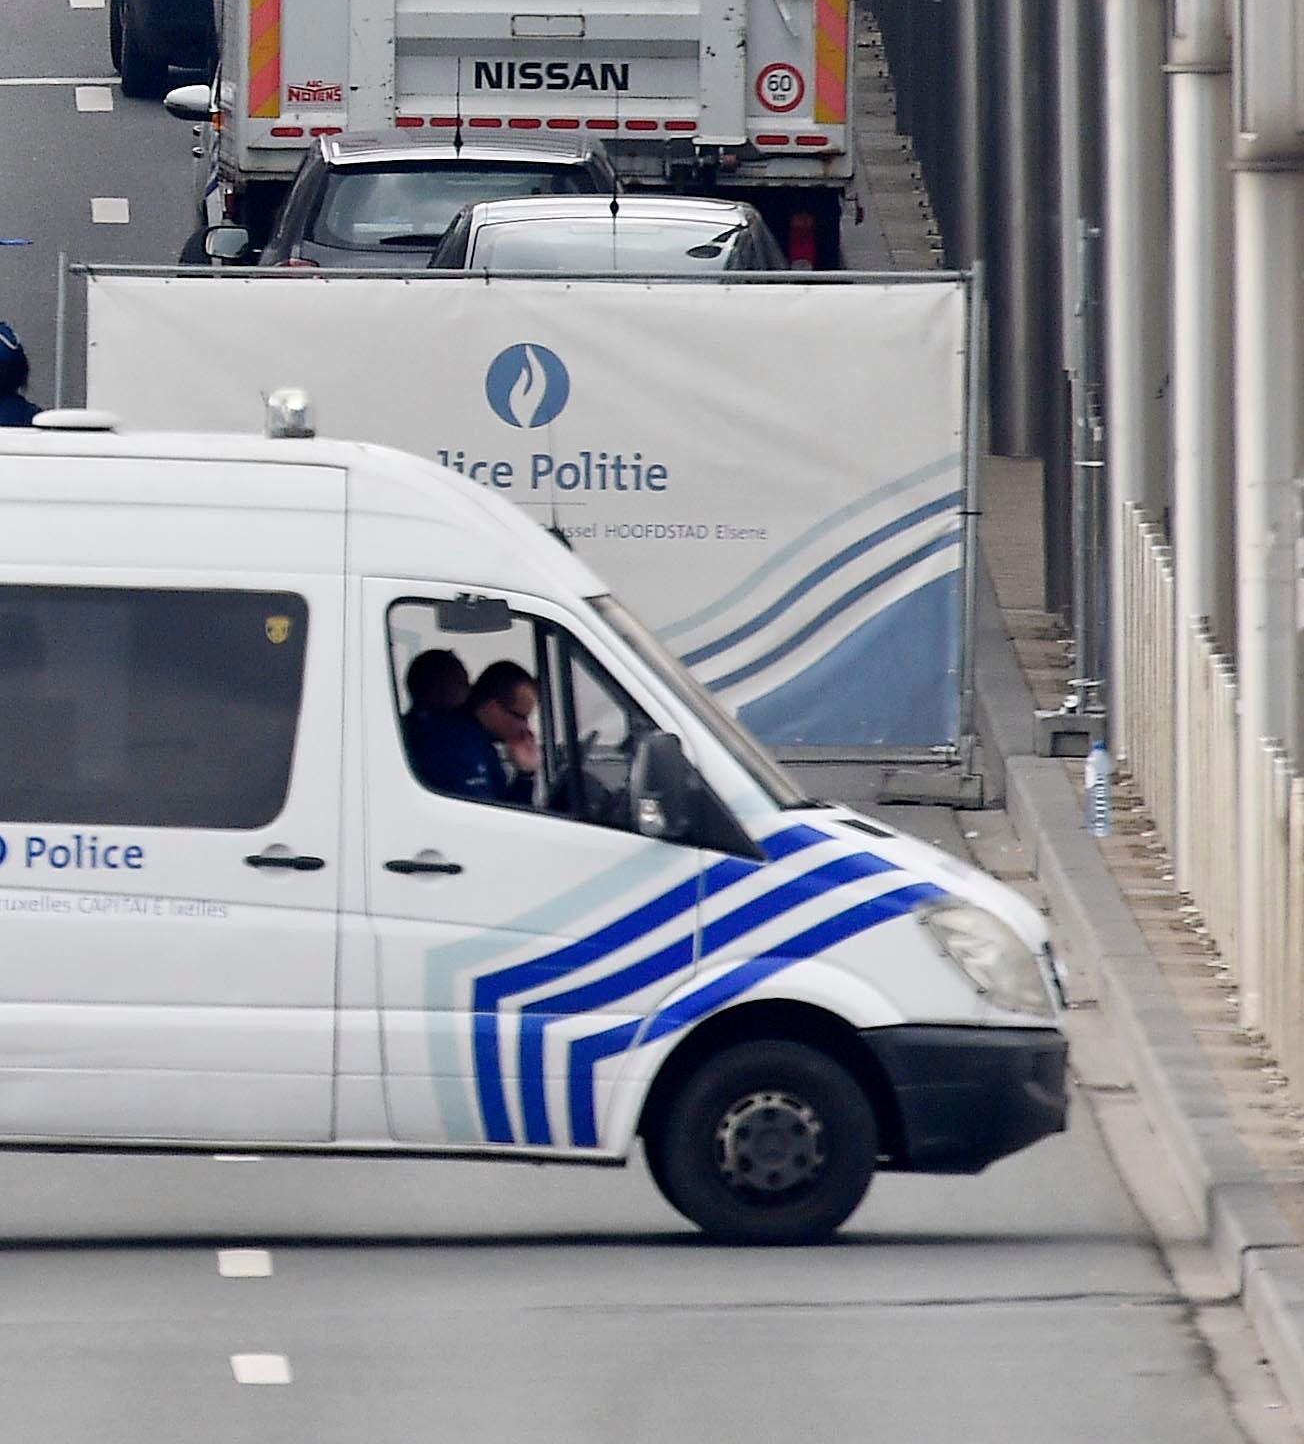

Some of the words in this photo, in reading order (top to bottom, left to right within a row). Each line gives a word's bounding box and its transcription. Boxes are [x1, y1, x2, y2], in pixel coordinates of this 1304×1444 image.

[474, 61, 630, 91] NISSAN
[767, 74, 792, 92] 60
[530, 452, 668, 492] Politie
[605, 524, 709, 540] HOOFDSTAD
[24, 834, 145, 870] Police
